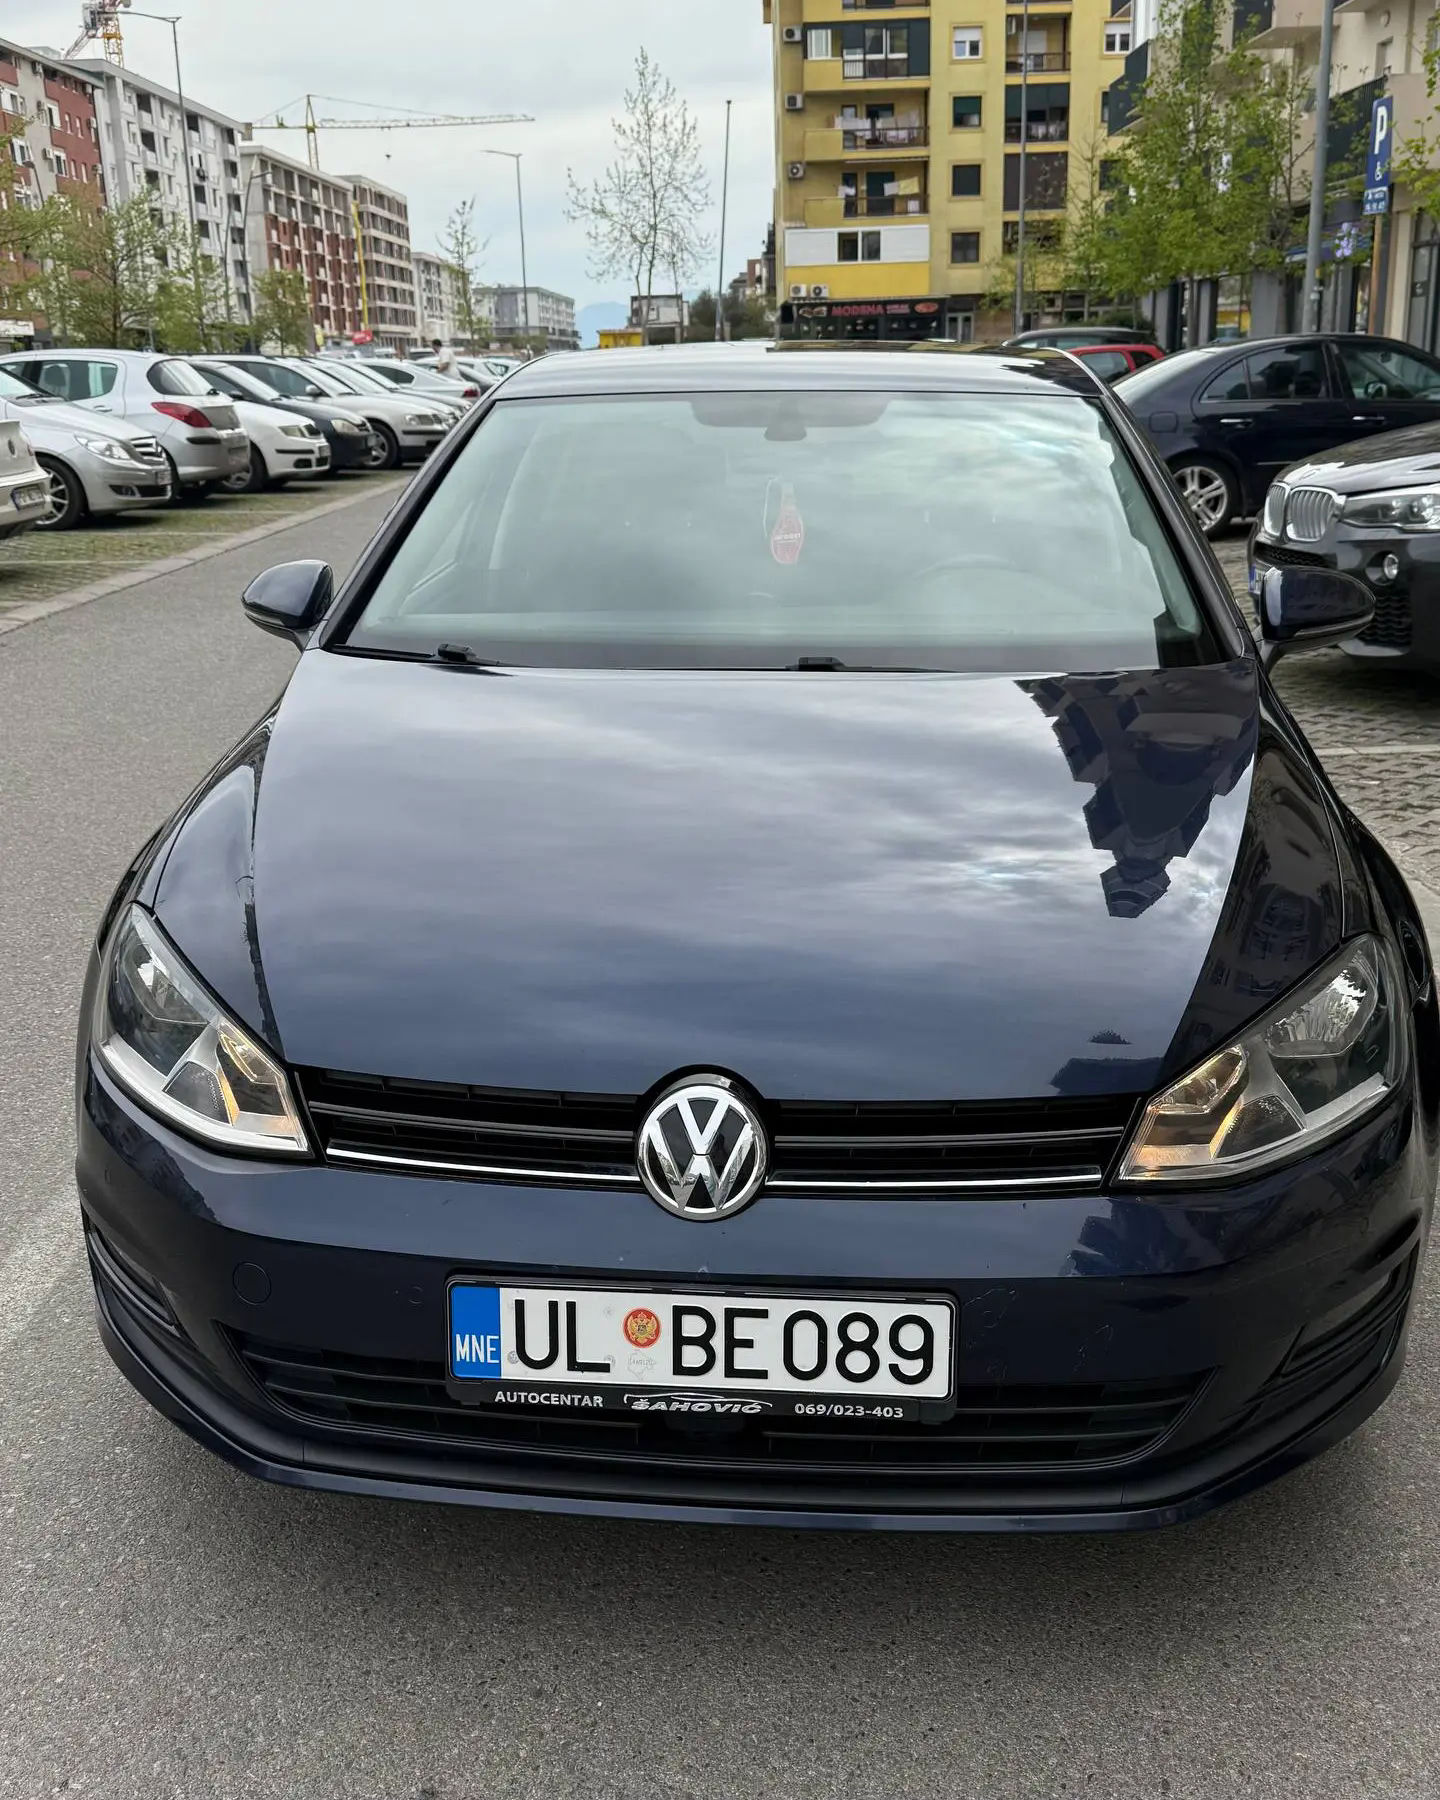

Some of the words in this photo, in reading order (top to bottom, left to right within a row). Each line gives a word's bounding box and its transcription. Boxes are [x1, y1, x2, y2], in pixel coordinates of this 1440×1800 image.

[1374, 105, 1388, 155] P
[831, 303, 886, 316] MODENA
[642, 1088, 762, 1216] VW
[455, 1334, 500, 1364] MNE
[514, 1299, 611, 1373] UL
[494, 1391, 604, 1407] AUTOCENTAR
[630, 1398, 762, 1416] ŠAHOVIĆ
[794, 1403, 905, 1419] 069/023-403
